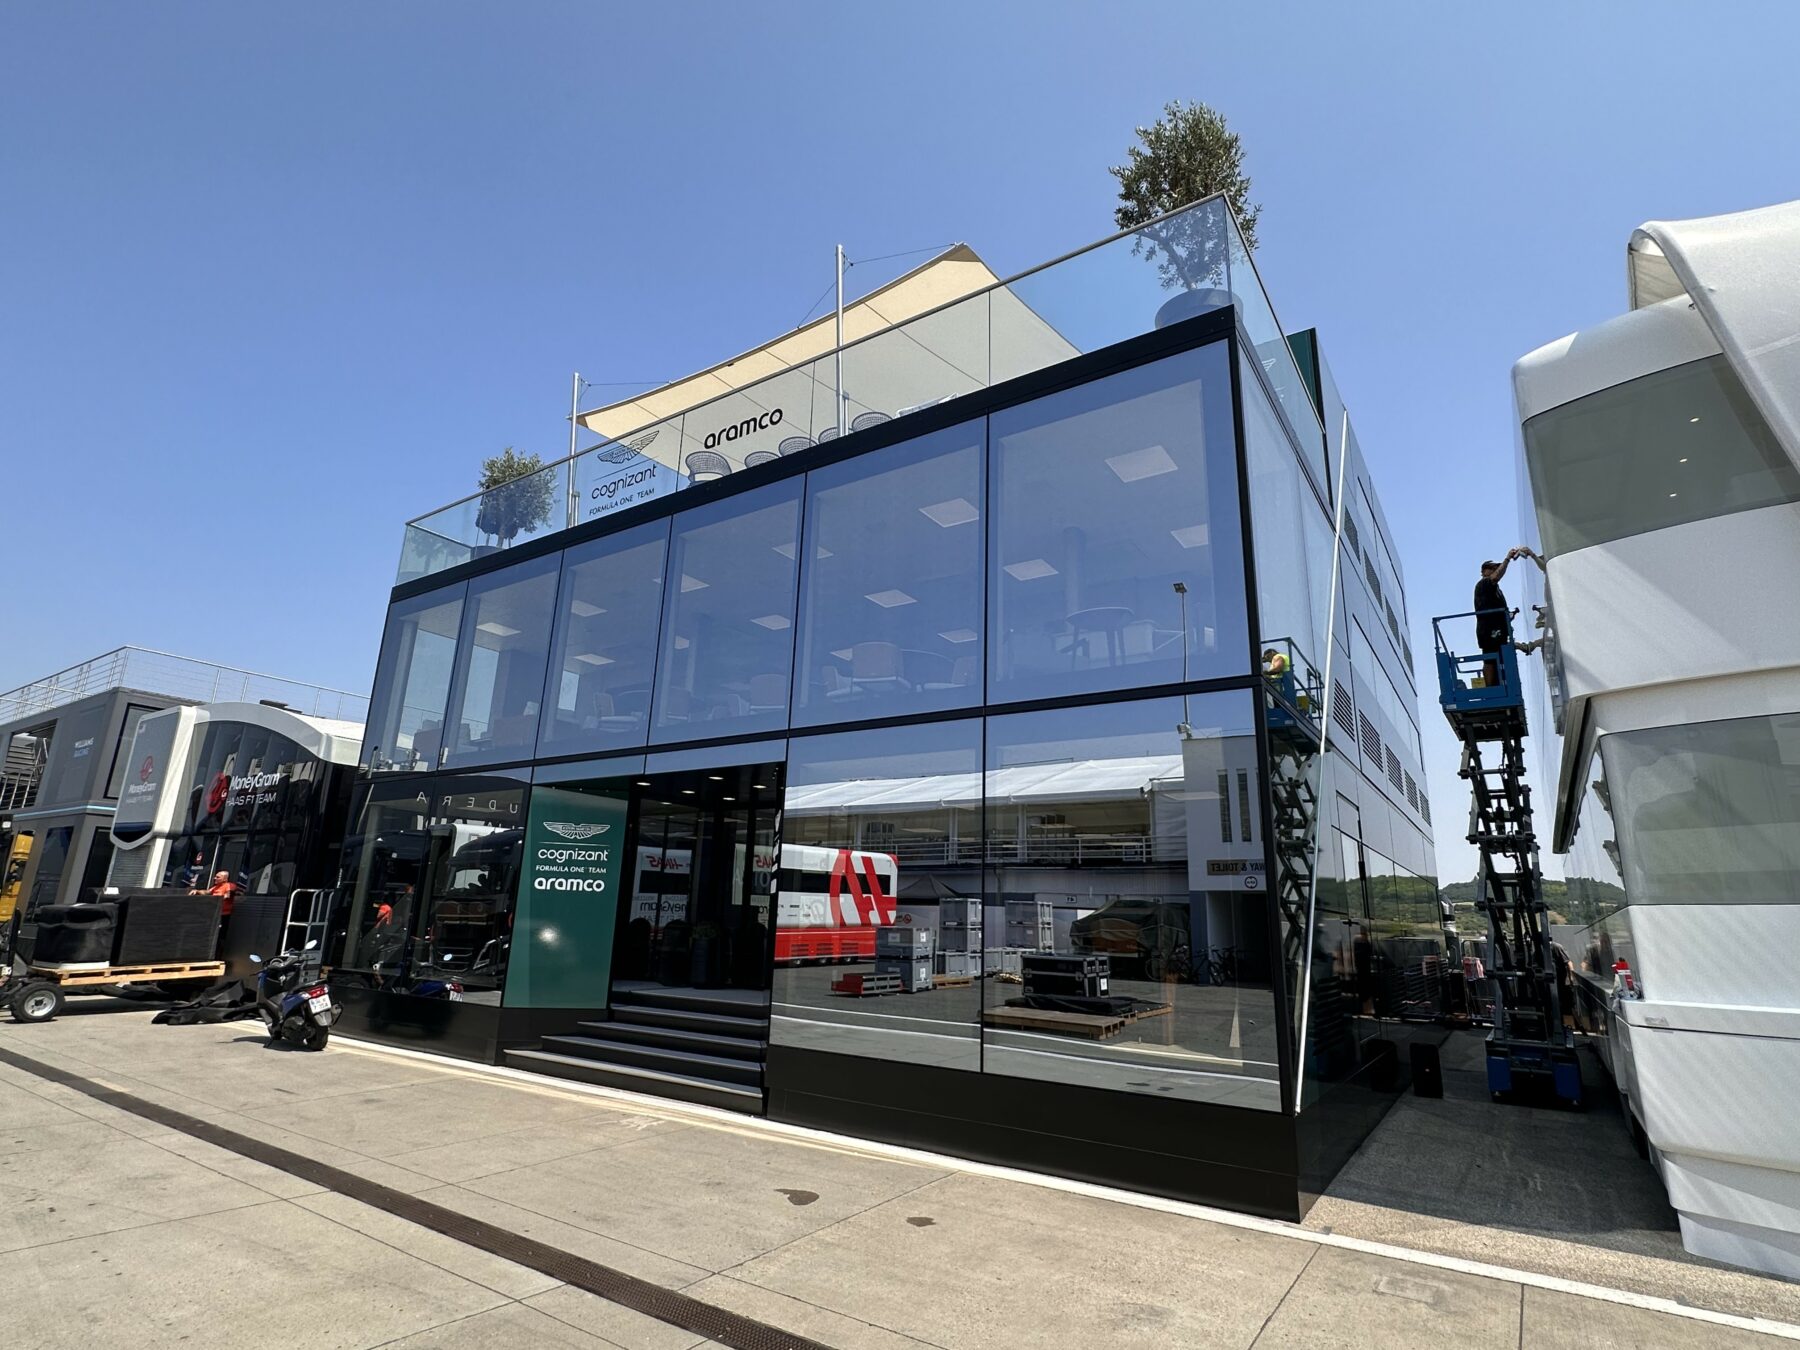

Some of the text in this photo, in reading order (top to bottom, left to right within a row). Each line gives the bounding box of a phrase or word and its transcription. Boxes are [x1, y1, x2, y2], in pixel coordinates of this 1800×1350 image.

[704, 408, 783, 449] aramco
[591, 463, 657, 499] cognizant
[589, 488, 655, 516] FORMULA ONE TEAM
[229, 772, 280, 792] MoneyGram
[245, 794, 255, 804] F1
[256, 792, 277, 804] TEAM
[538, 848, 609, 863] cognizant
[534, 877, 605, 892] aramco
